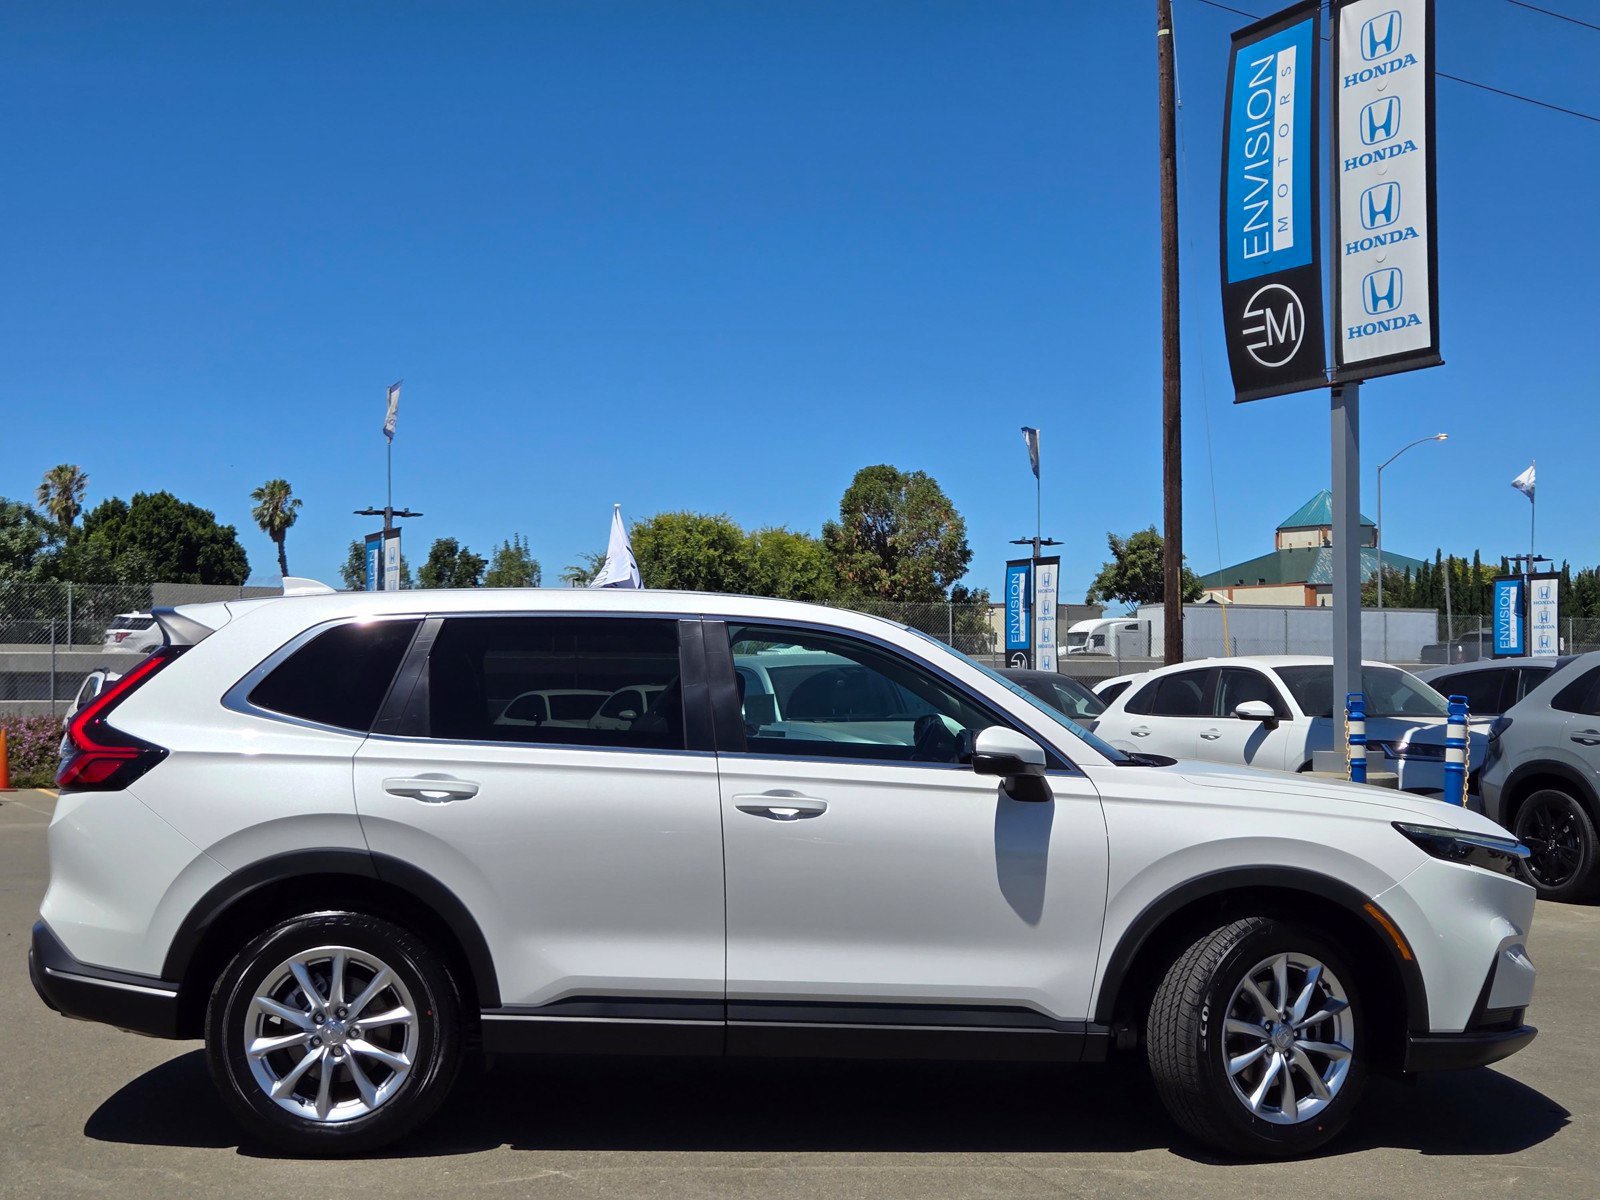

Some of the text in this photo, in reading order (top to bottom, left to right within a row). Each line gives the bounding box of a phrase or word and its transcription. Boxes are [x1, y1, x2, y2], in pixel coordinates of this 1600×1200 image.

[1343, 53, 1418, 89] HONDA
[1243, 54, 1275, 259] ENVISION
[1277, 66, 1291, 233] MOTORS
[1343, 139, 1418, 173] HONDA
[1345, 226, 1420, 256] HONDA
[1347, 313, 1423, 340] HONDA
[1010, 573, 1020, 643] ENVISION
[1500, 586, 1510, 649] ENVISION
